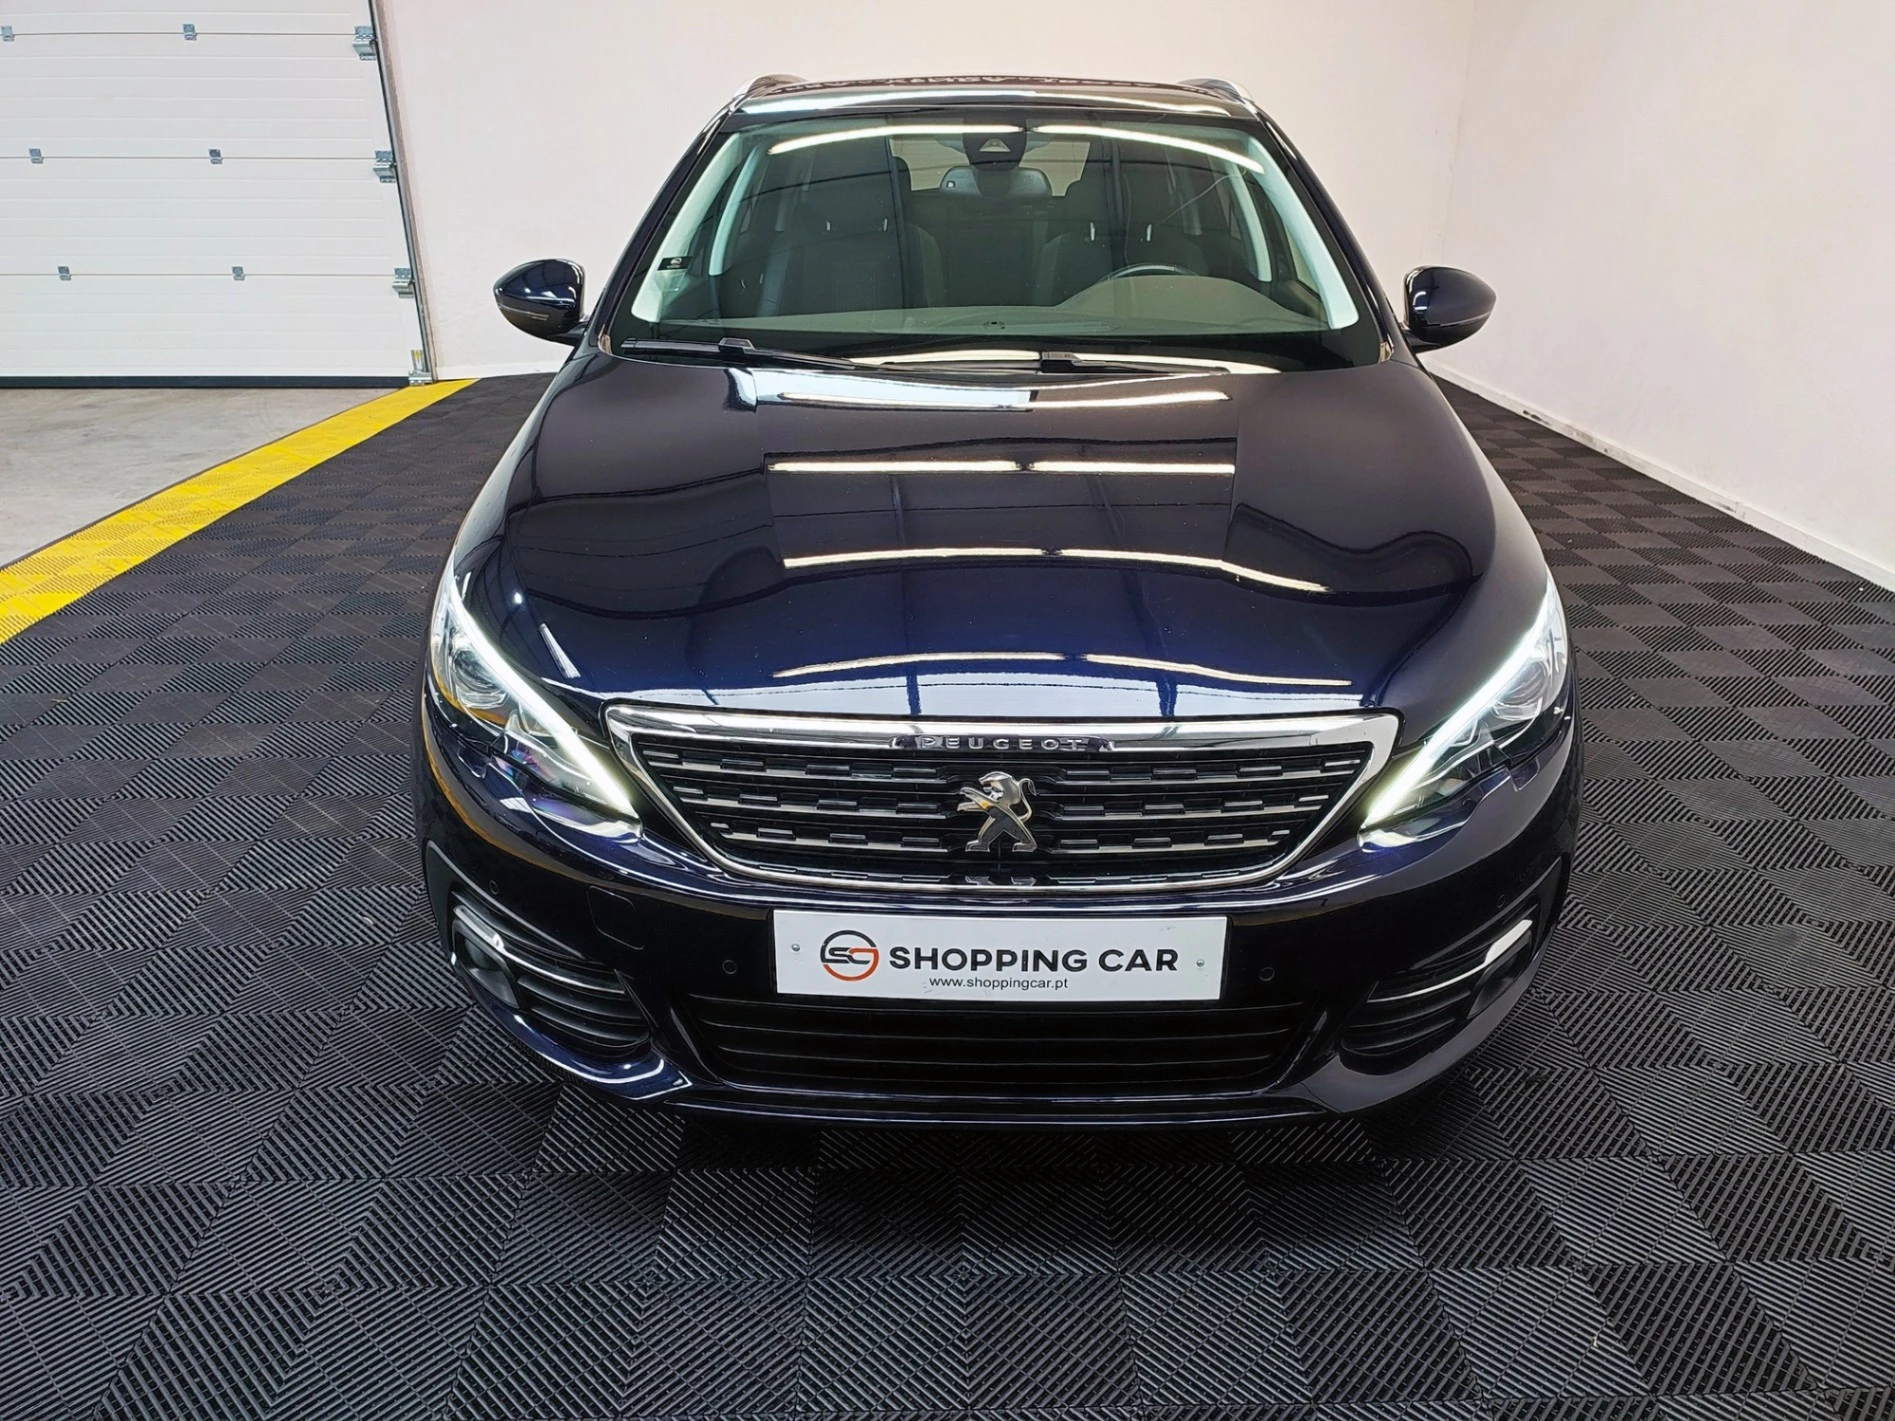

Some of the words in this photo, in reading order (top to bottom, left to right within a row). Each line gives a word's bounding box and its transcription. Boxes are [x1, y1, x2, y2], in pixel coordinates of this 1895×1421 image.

[920, 735, 1084, 750] PEUGEOT
[889, 947, 1087, 972] SHOPPING
[1098, 949, 1179, 972] CAR
[929, 976, 1069, 991] www.shoppingcar.pt
